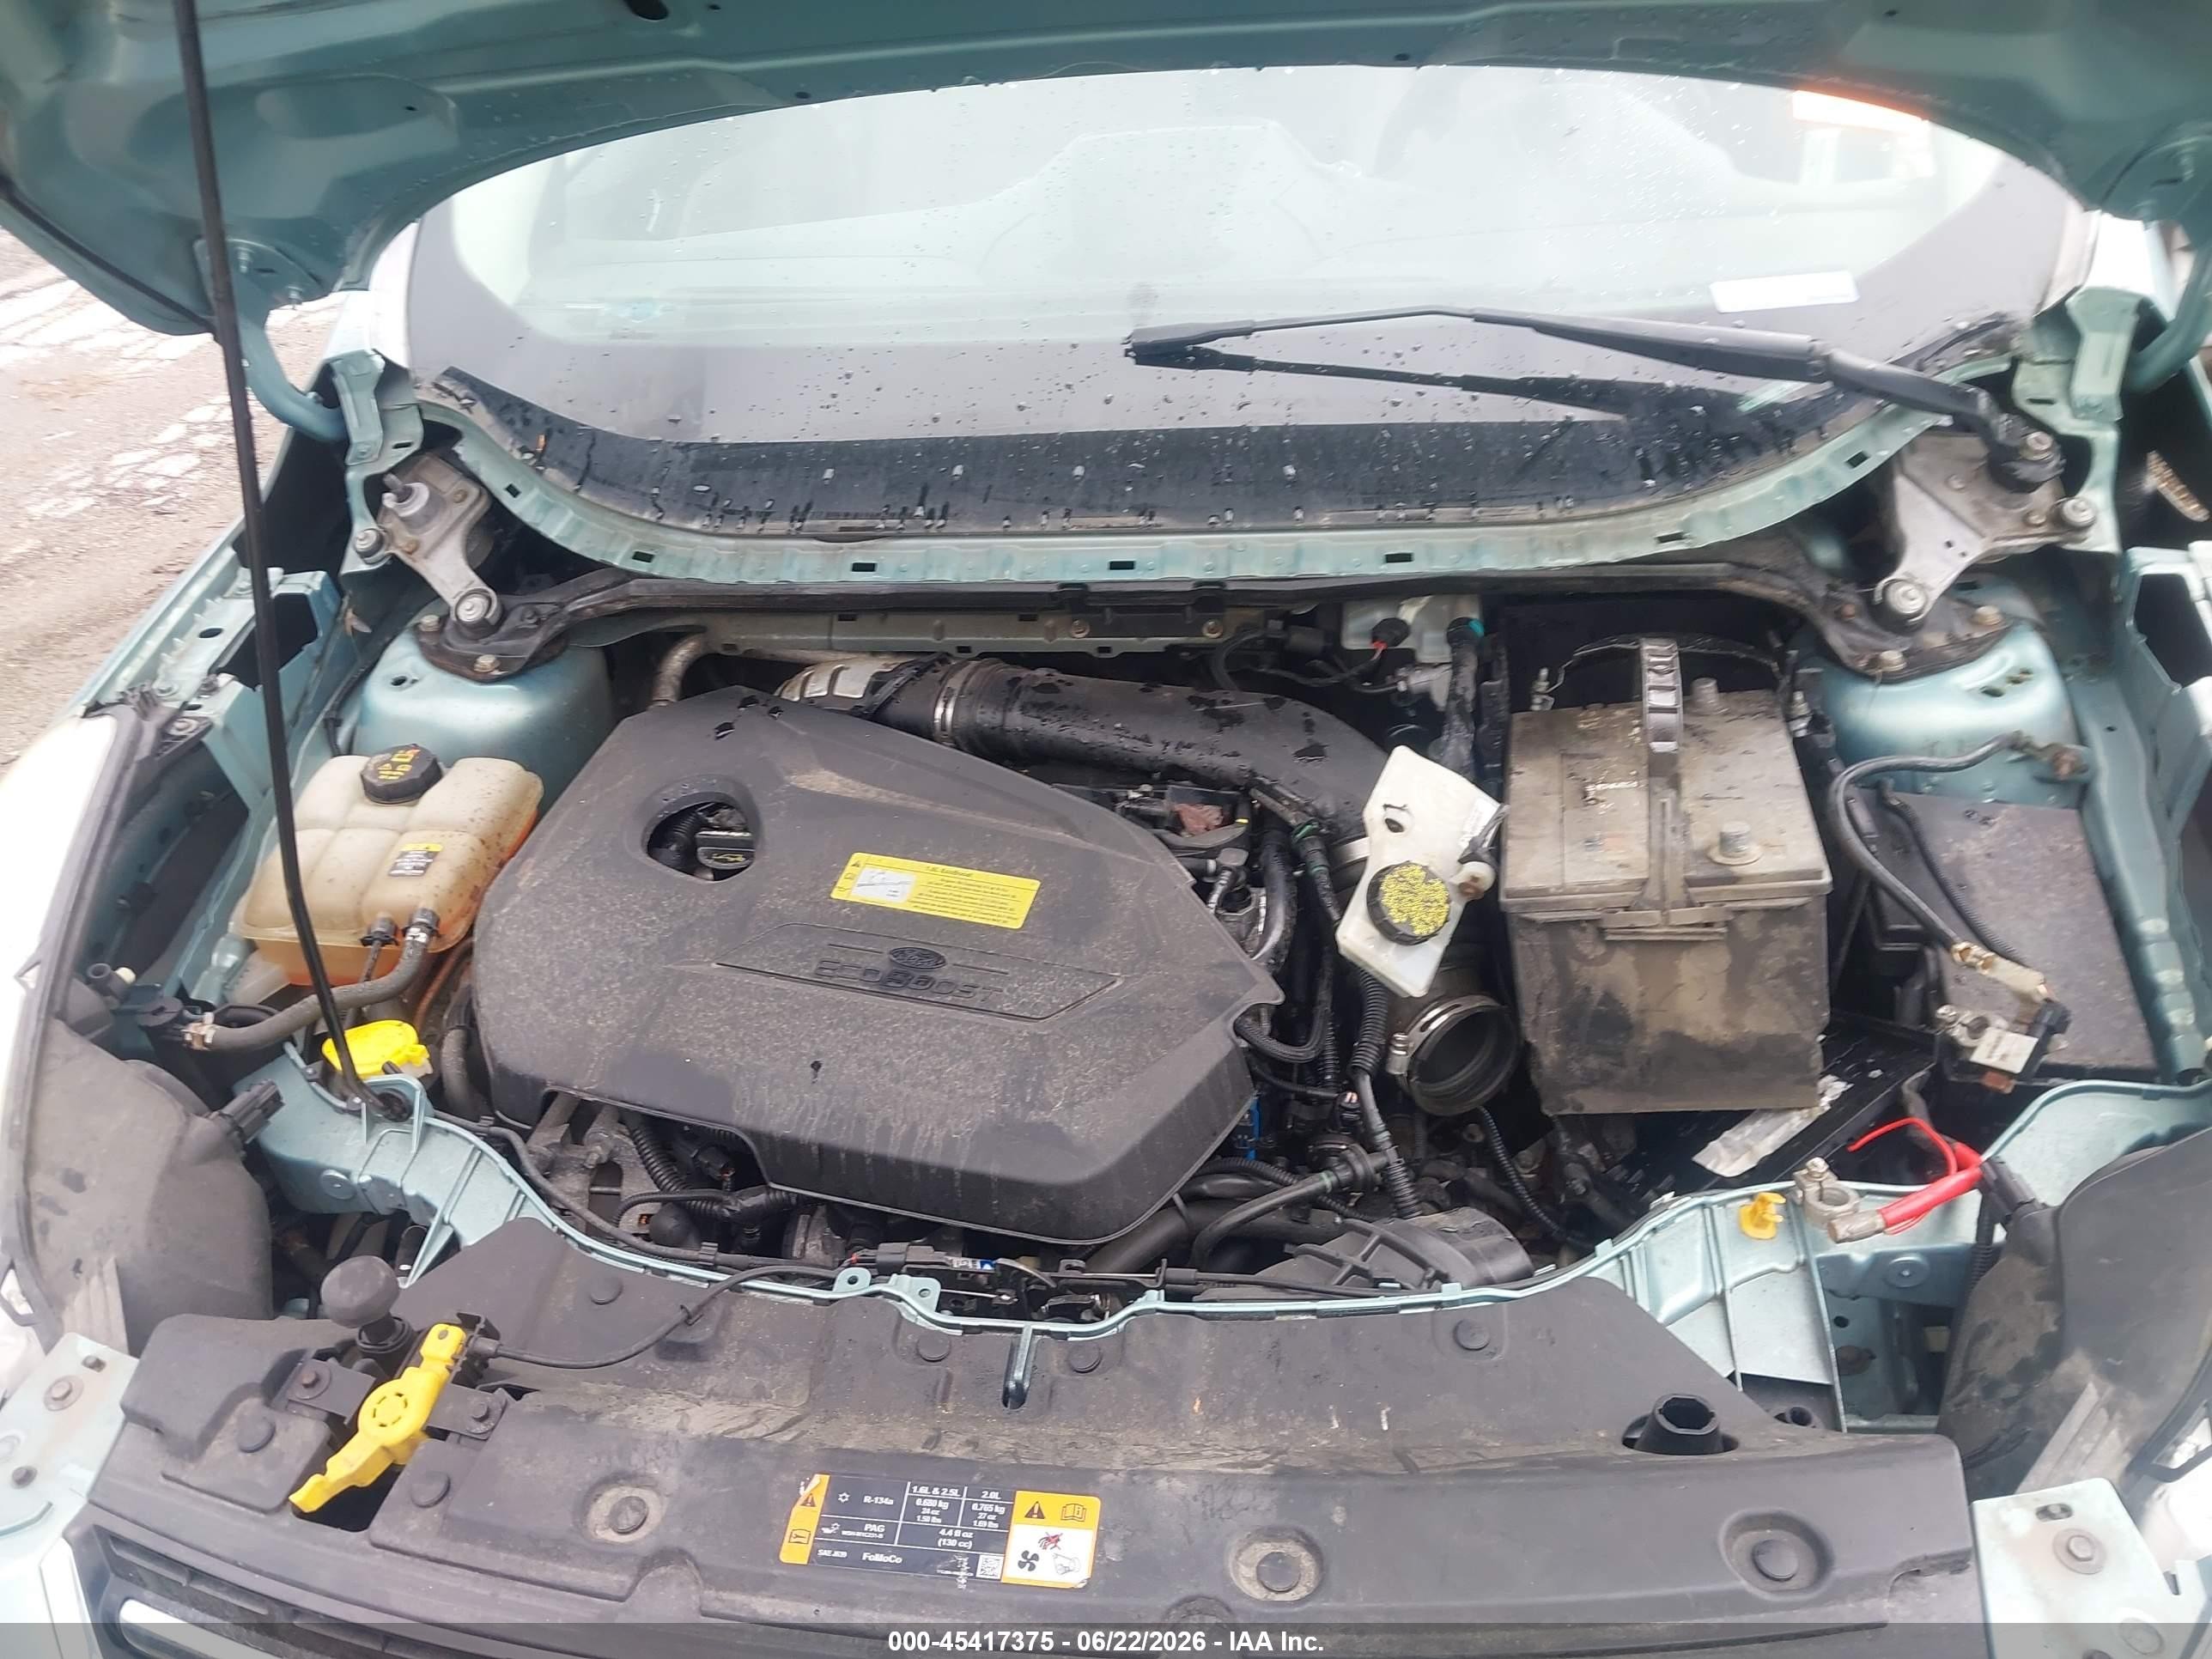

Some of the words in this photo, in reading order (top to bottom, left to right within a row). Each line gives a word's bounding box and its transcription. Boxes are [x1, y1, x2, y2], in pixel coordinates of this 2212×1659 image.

[932, 1486, 940, 1495] &
[981, 1490, 1002, 1500] 2.0L
[863, 1495, 894, 1505] R-134a
[938, 1499, 950, 1510] kg
[994, 1504, 1006, 1515] kg
[864, 1522, 885, 1533] PAG
[939, 1528, 953, 1536] 4.4
[938, 1538, 957, 1547] (130
[957, 1540, 973, 1550] cc)
[861, 1552, 902, 1564] FoMoCo
